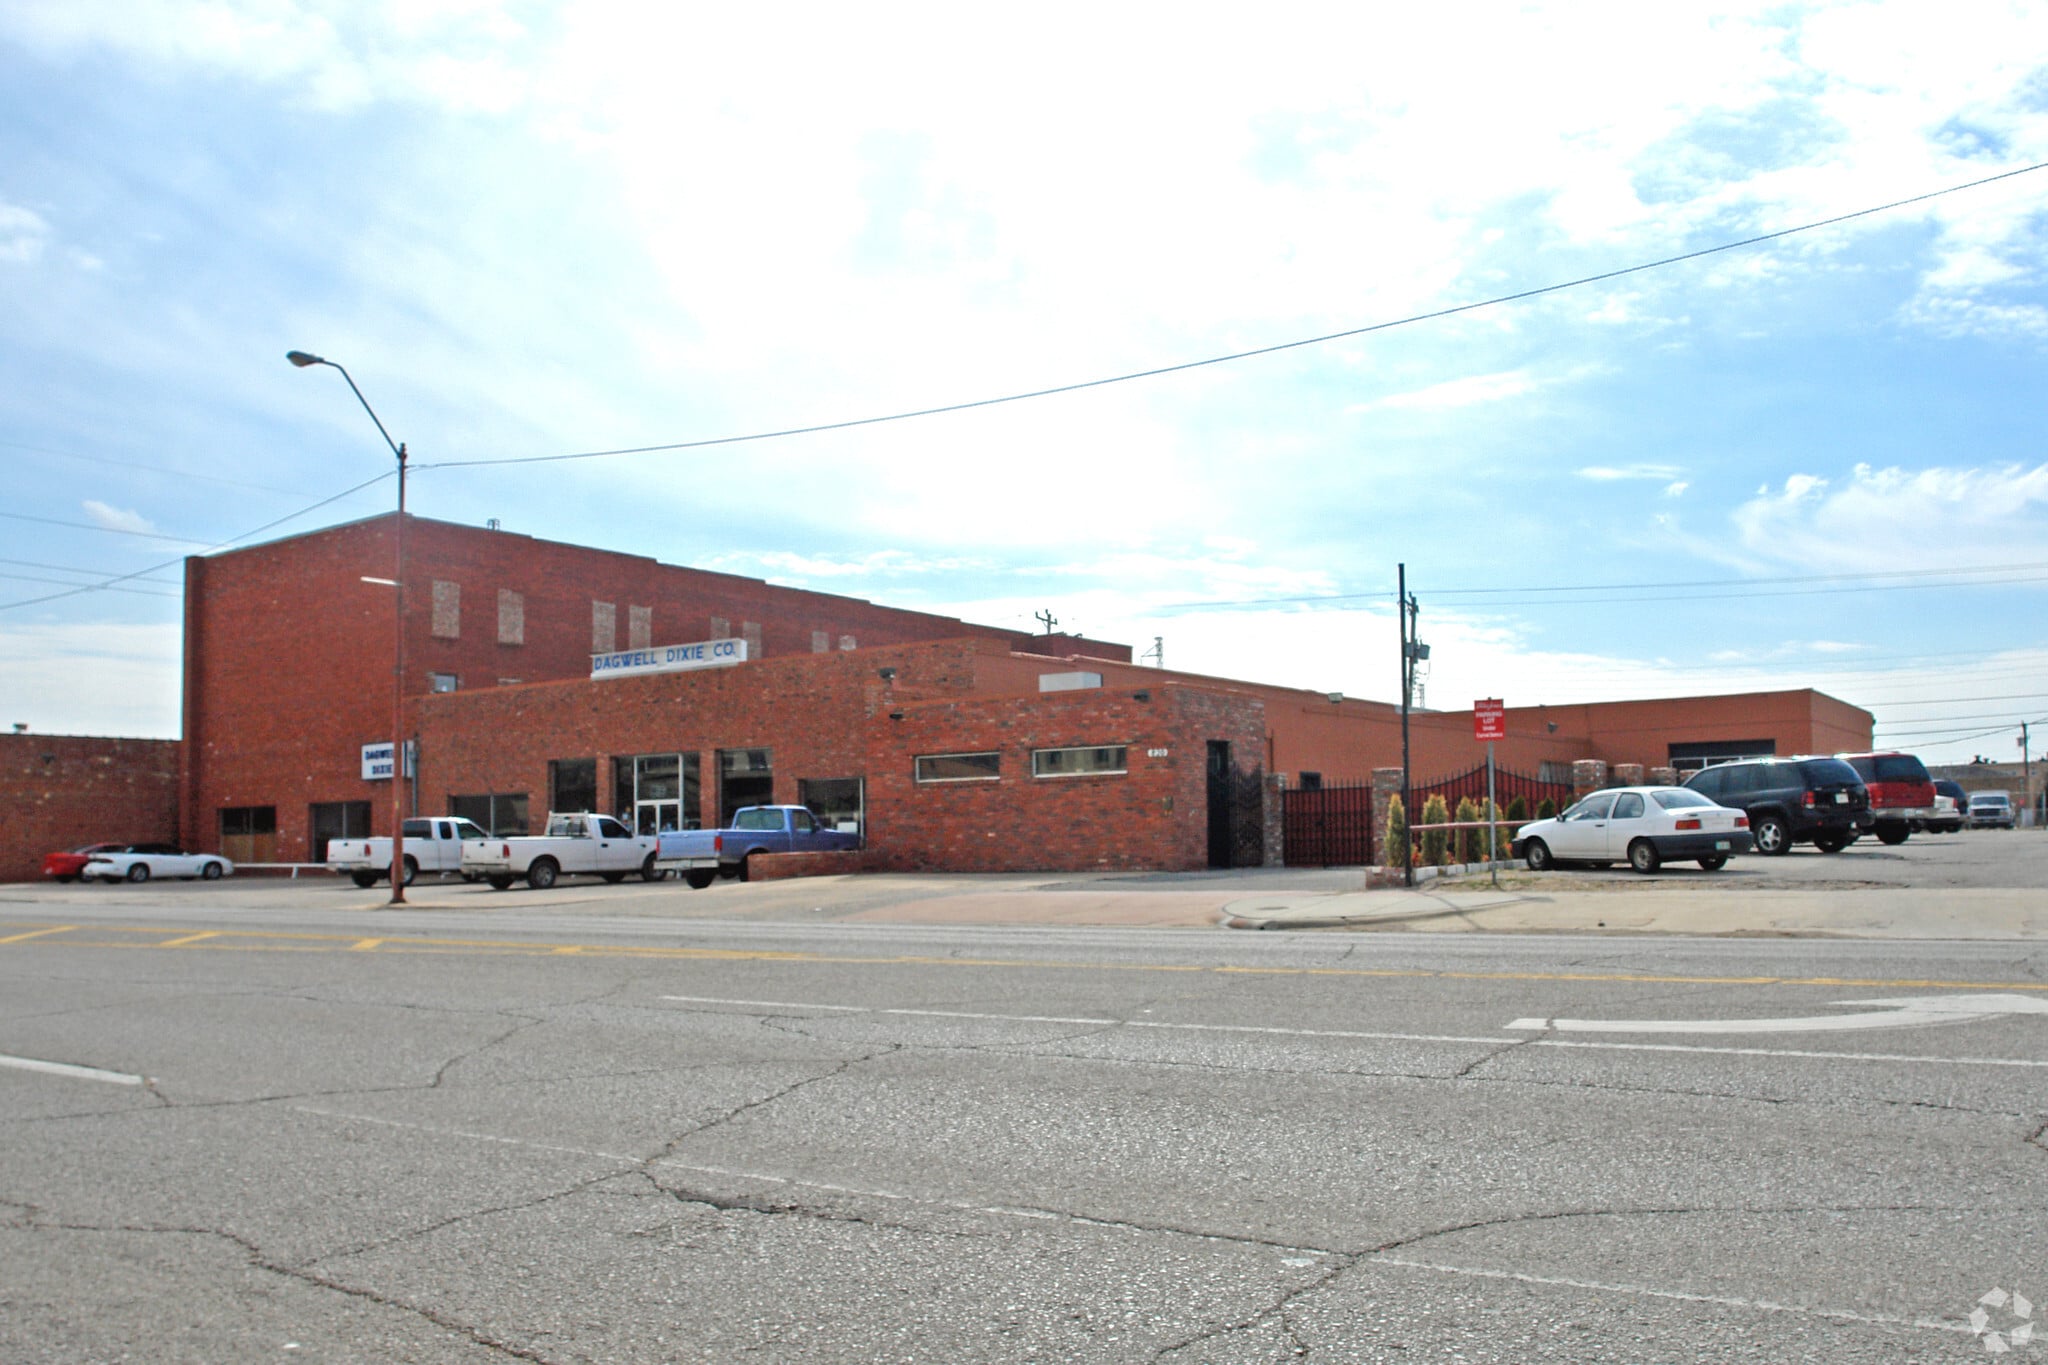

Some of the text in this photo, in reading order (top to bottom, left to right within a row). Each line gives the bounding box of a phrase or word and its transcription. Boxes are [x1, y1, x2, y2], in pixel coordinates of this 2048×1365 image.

[594, 642, 736, 670] DAGWELL DIXIE CO.
[372, 764, 392, 775] DIXIE
